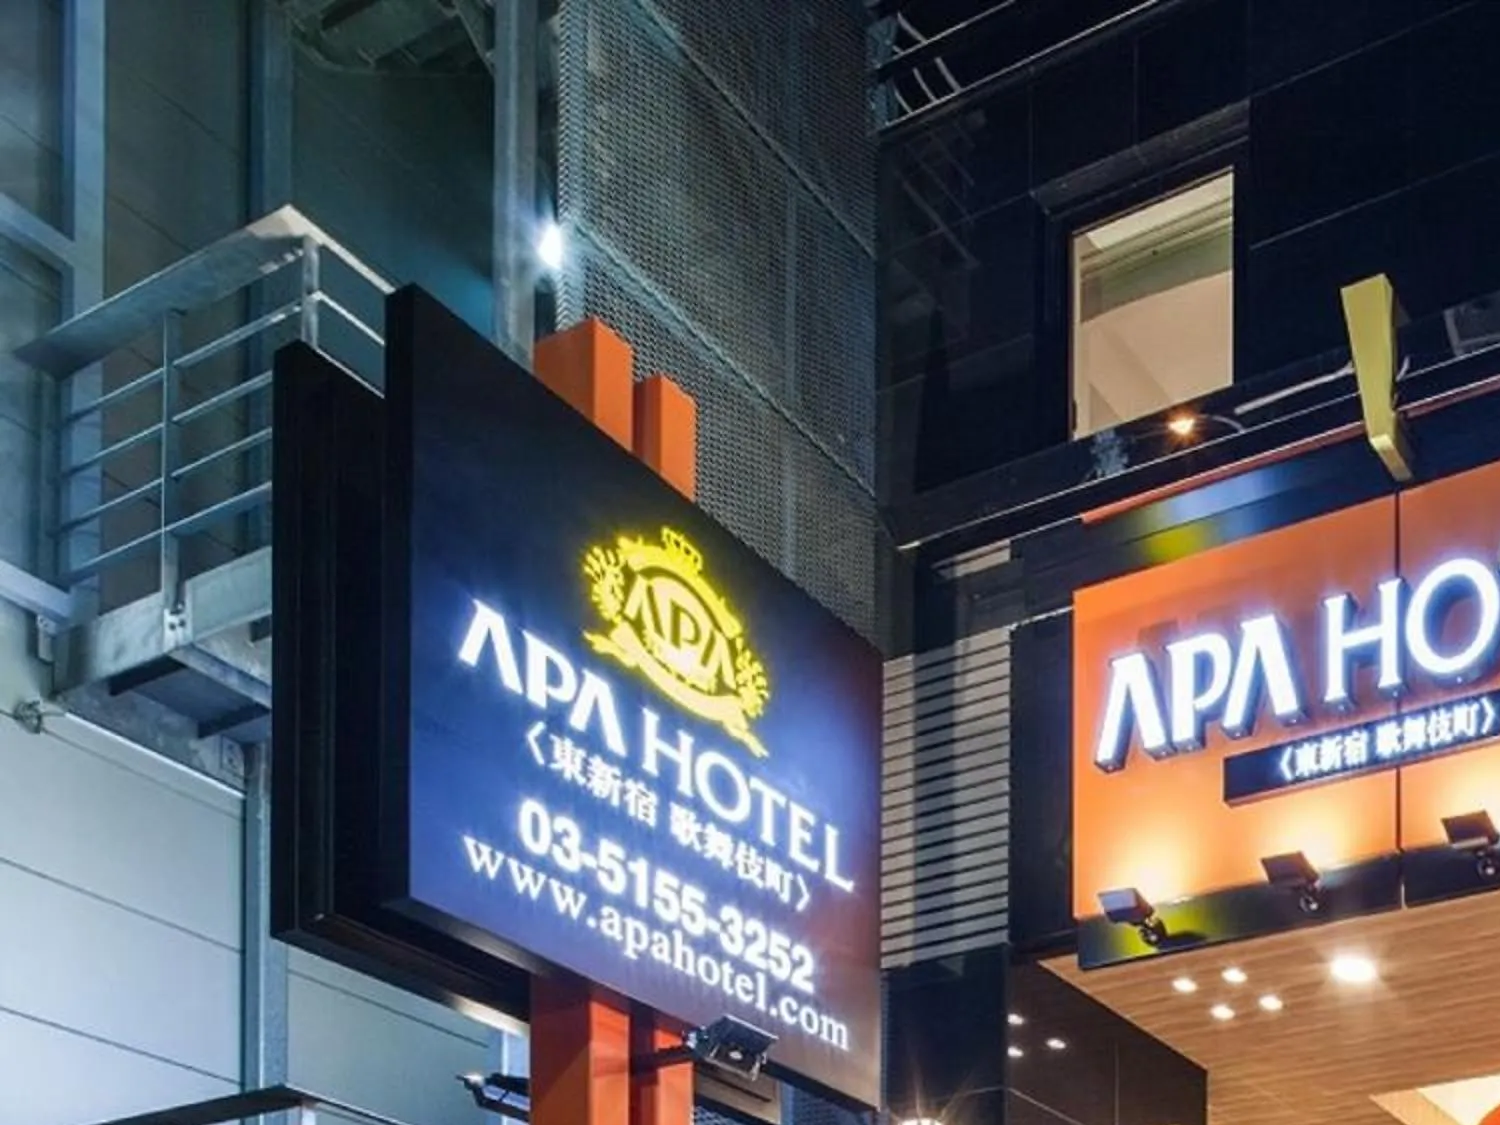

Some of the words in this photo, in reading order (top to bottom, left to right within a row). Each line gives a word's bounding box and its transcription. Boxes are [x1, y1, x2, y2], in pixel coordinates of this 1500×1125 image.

[457, 600, 628, 758] APA
[641, 706, 854, 892] HOTEL
[1096, 613, 1301, 768] APA
[461, 834, 850, 1052] www.apahotel.com
[517, 799, 815, 994] 03-5155-3252
